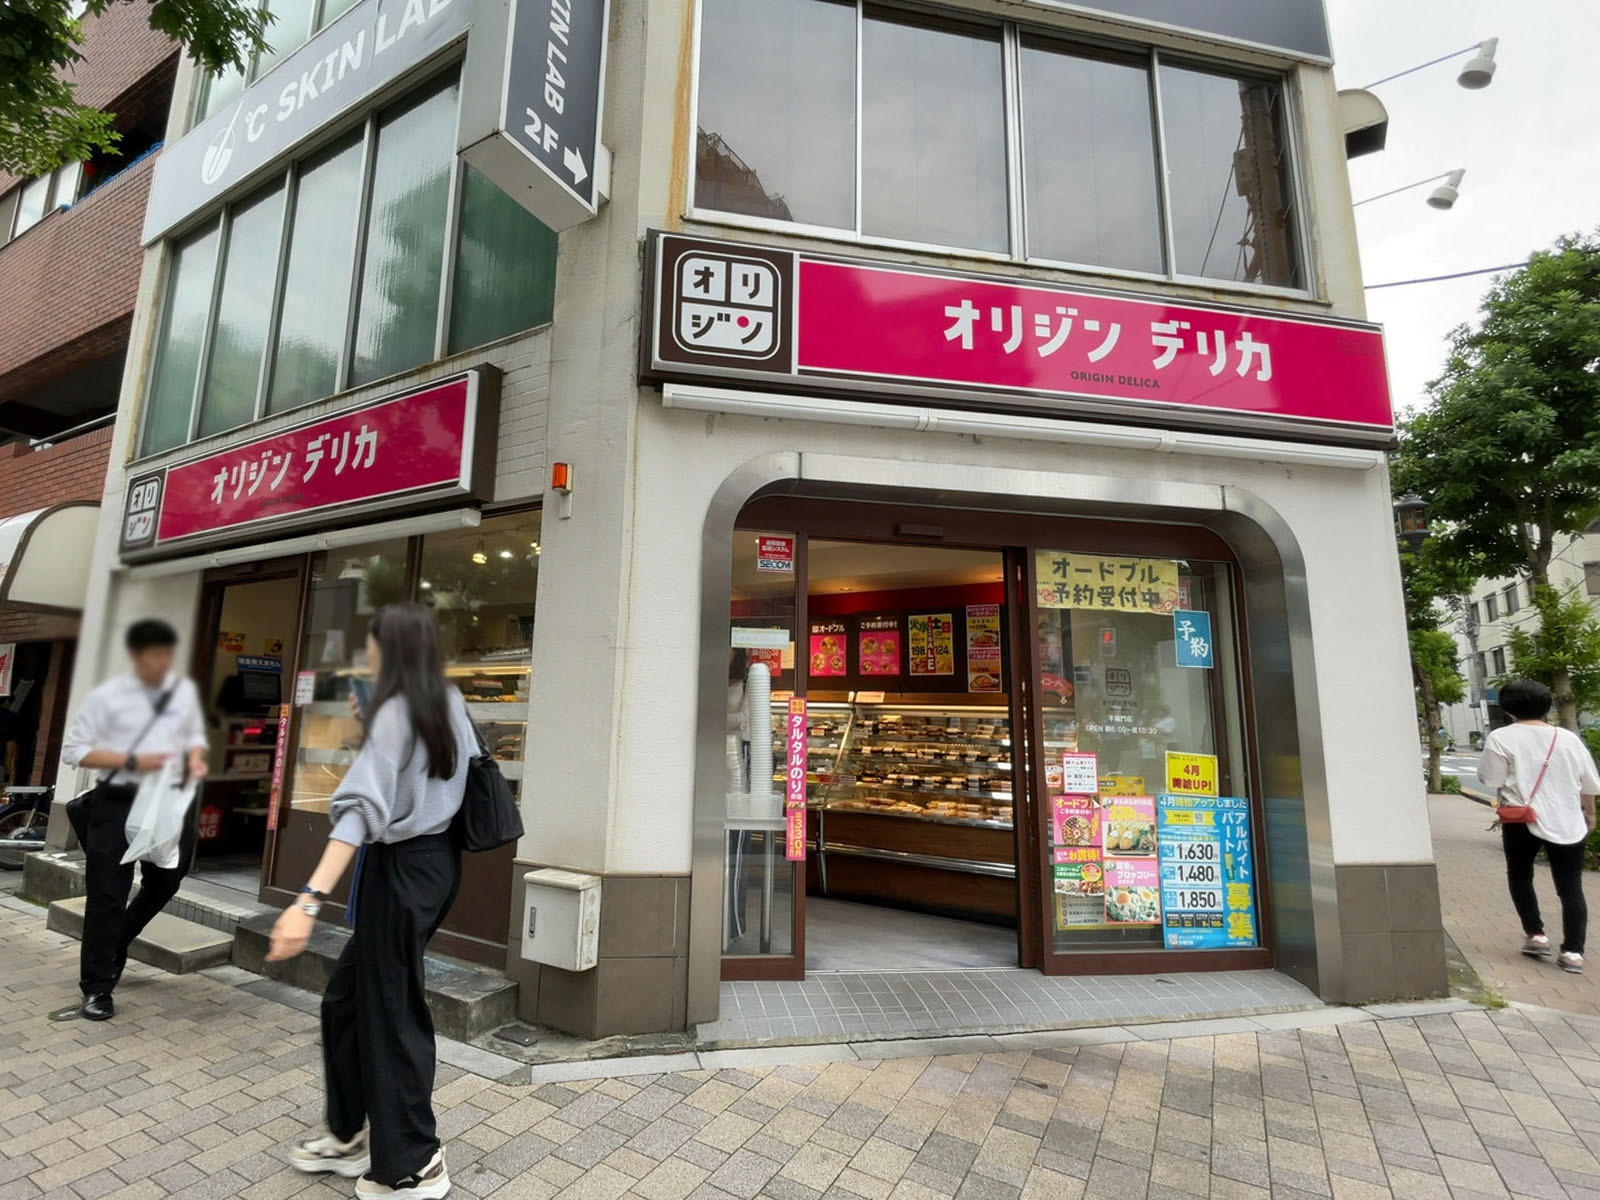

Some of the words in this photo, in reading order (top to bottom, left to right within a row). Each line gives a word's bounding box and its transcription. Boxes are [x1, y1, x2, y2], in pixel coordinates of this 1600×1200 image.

[550, 0, 571, 46] IN
[276, 29, 366, 123] SKIN
[544, 40, 568, 114] LAB
[523, 107, 559, 155] 2F
[943, 299, 1121, 363] オリジン
[1151, 320, 1272, 382] デリカ
[1070, 369, 1114, 385] ORIGIN
[1118, 375, 1161, 390] DELICA
[210, 450, 292, 505] オリジン
[302, 424, 378, 483] デリカ
[760, 559, 791, 569] SECOM
[1052, 557, 1161, 584] オードブル
[1053, 581, 1161, 609] 予約受付中
[1177, 620, 1209, 659] 予約
[1085, 724, 1103, 732] OPEN
[790, 714, 803, 793] タルタルのり
[1235, 812, 1249, 879] アルバイト
